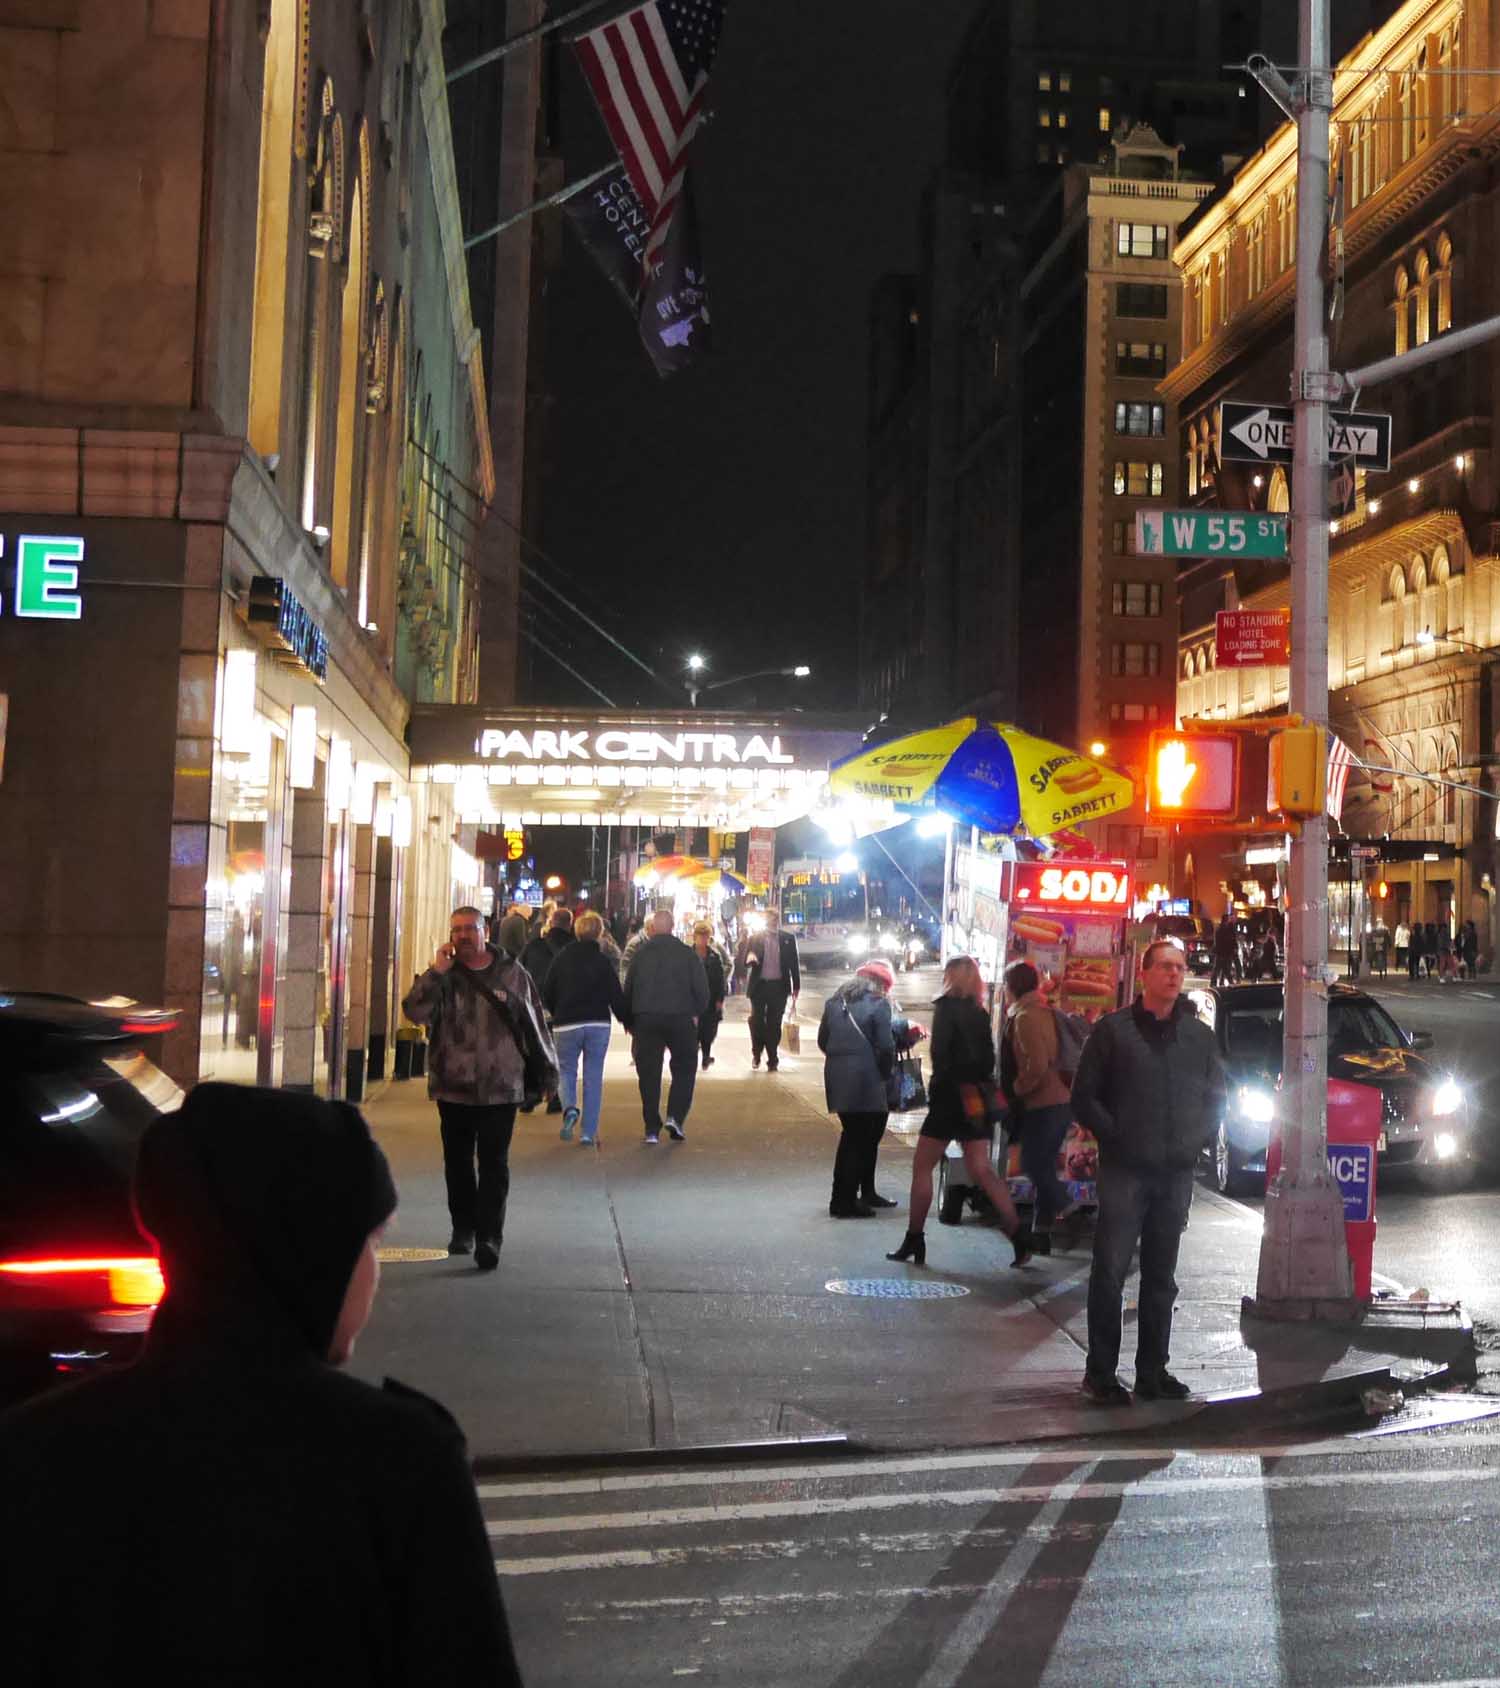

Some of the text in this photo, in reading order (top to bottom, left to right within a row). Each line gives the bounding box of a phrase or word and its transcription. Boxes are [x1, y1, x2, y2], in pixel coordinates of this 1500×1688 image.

[594, 190, 643, 263] HOTEL
[1248, 423, 1293, 446] ONE
[1172, 516, 1281, 551] W 55 ST
[0, 534, 84, 620] E
[1223, 615, 1284, 628] NO STANDING
[1238, 629, 1265, 638] HOTEL
[1224, 639, 1281, 650] LOADING ZONE
[480, 729, 794, 764] PARK CENTRAL
[854, 781, 913, 799] SABRETT
[1051, 792, 1119, 826] SABRETT
[1326, 1156, 1367, 1183] ICE
